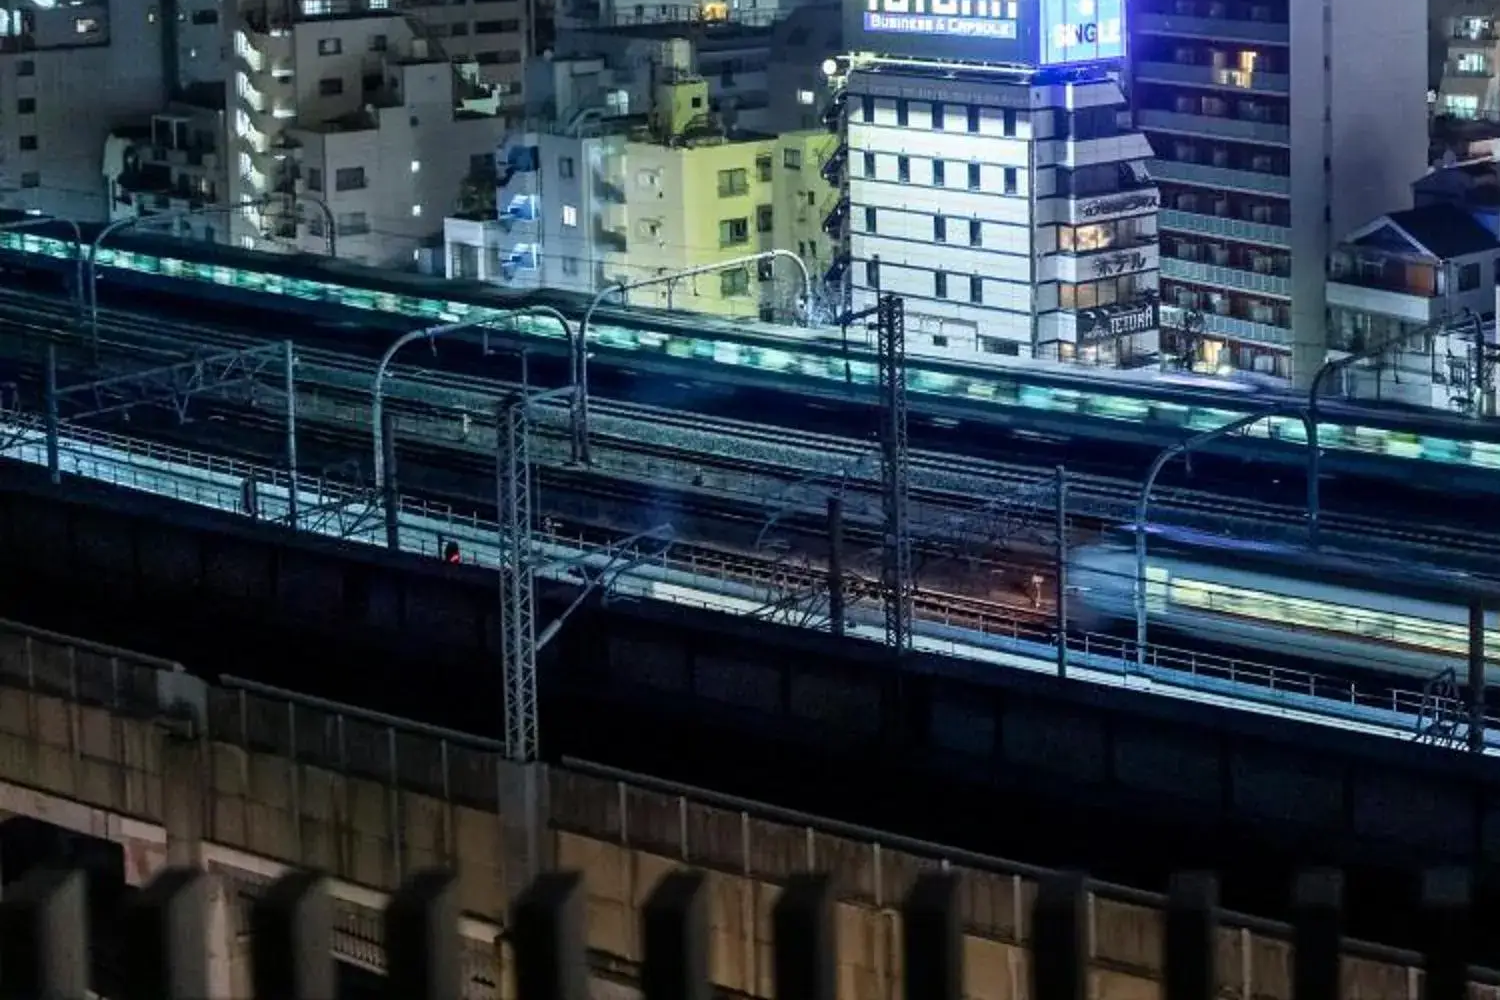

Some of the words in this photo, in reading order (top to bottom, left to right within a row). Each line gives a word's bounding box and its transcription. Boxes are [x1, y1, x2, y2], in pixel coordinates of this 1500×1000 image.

[1094, 251, 1147, 276] ホテル
[1110, 302, 1154, 335] TETORA
